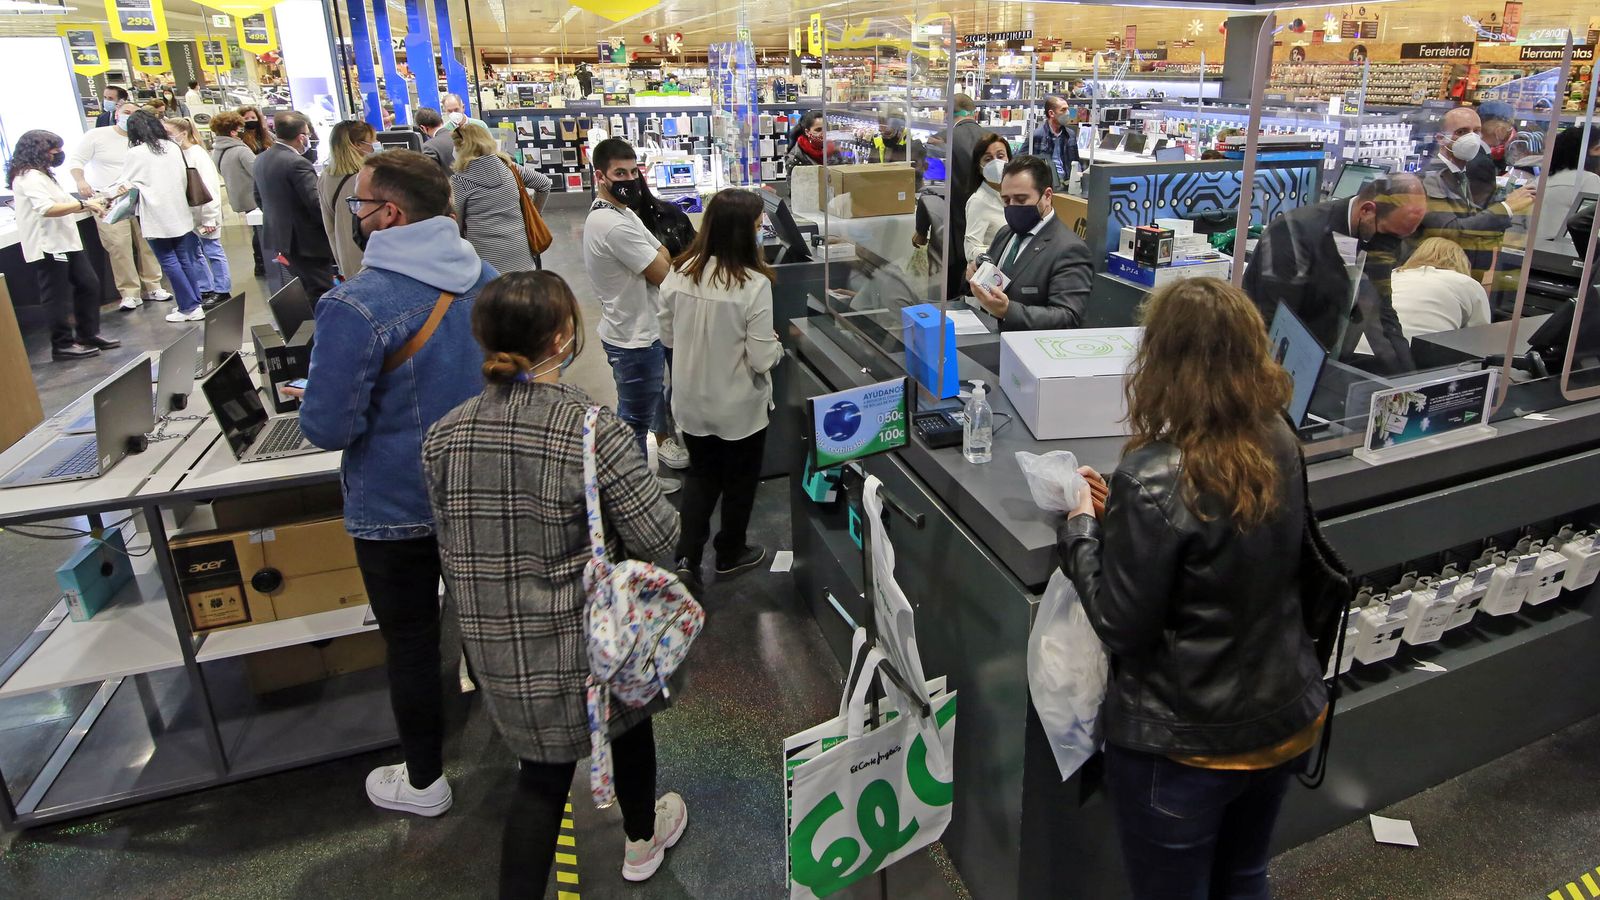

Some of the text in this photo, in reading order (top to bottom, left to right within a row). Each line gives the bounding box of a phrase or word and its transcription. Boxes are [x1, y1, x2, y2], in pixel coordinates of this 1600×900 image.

[1420, 44, 1470, 57] Ferretería
[1522, 46, 1592, 59] Herramintas
[189, 560, 226, 573] acer
